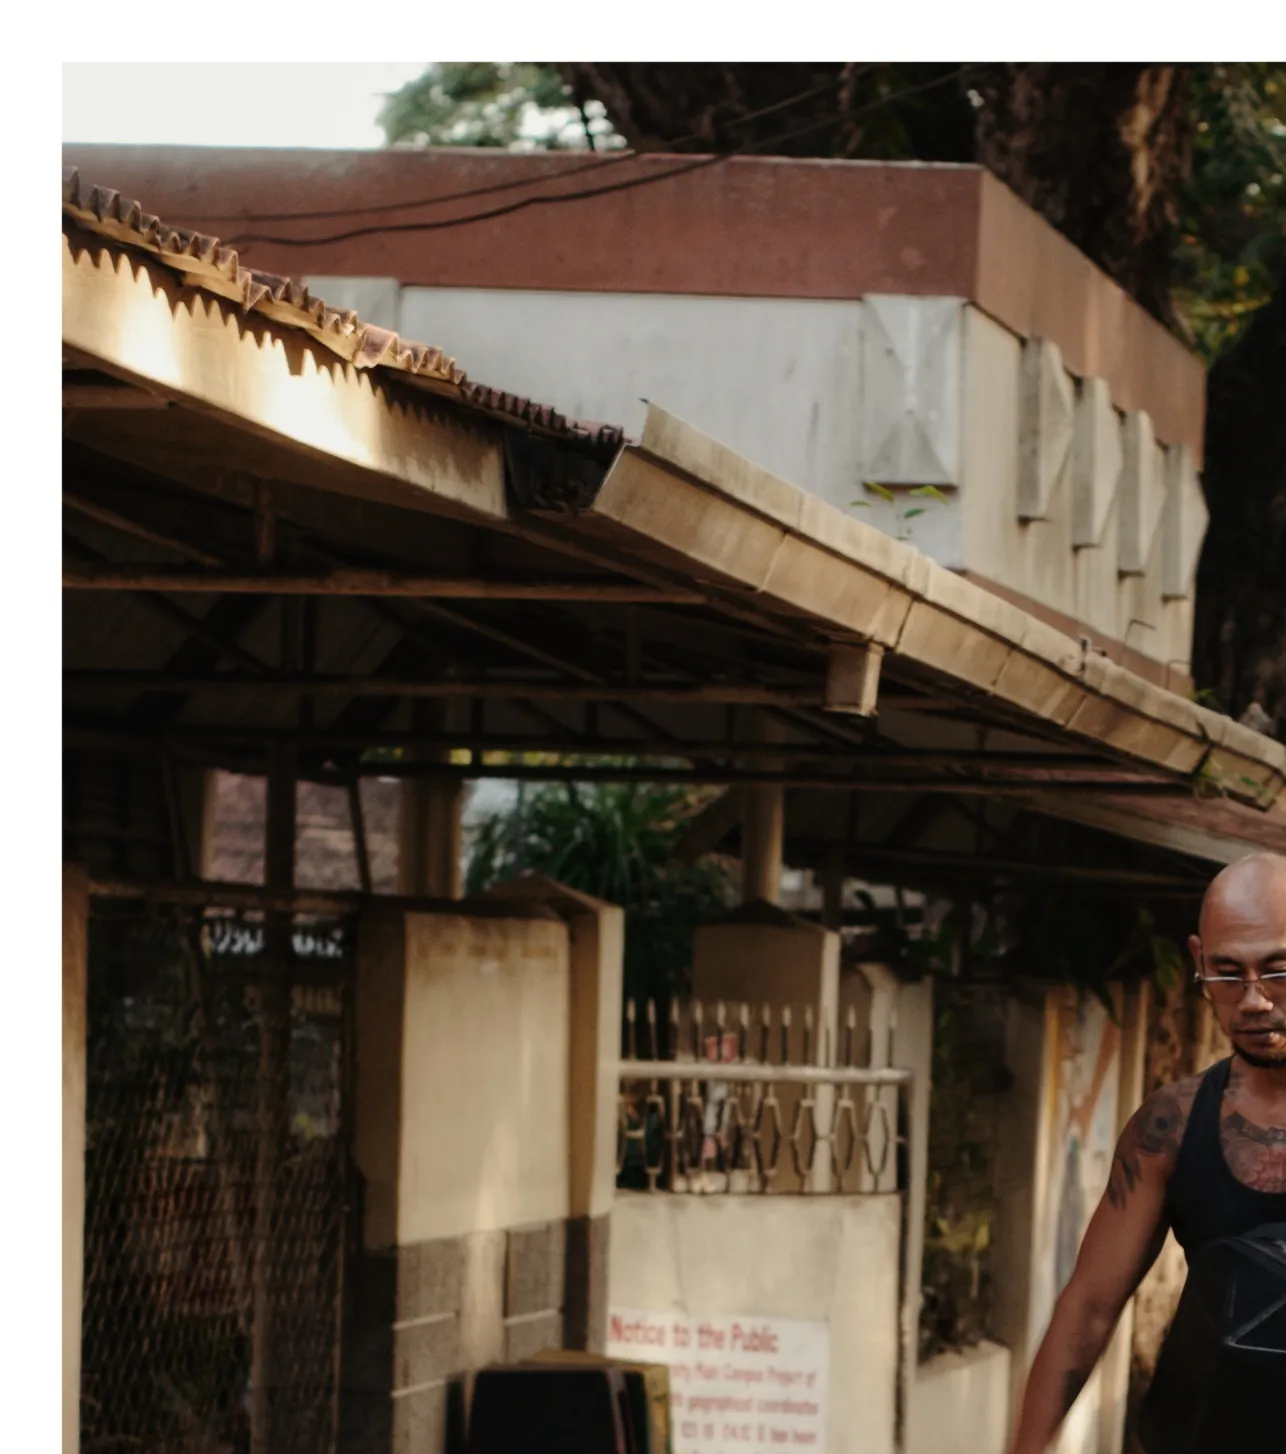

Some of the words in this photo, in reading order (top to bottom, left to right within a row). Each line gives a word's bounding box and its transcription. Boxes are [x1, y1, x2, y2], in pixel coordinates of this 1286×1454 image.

[611, 1315, 665, 1346] Notice
[673, 1322, 690, 1348] to
[698, 1321, 725, 1349] the
[731, 1322, 778, 1353] Public
